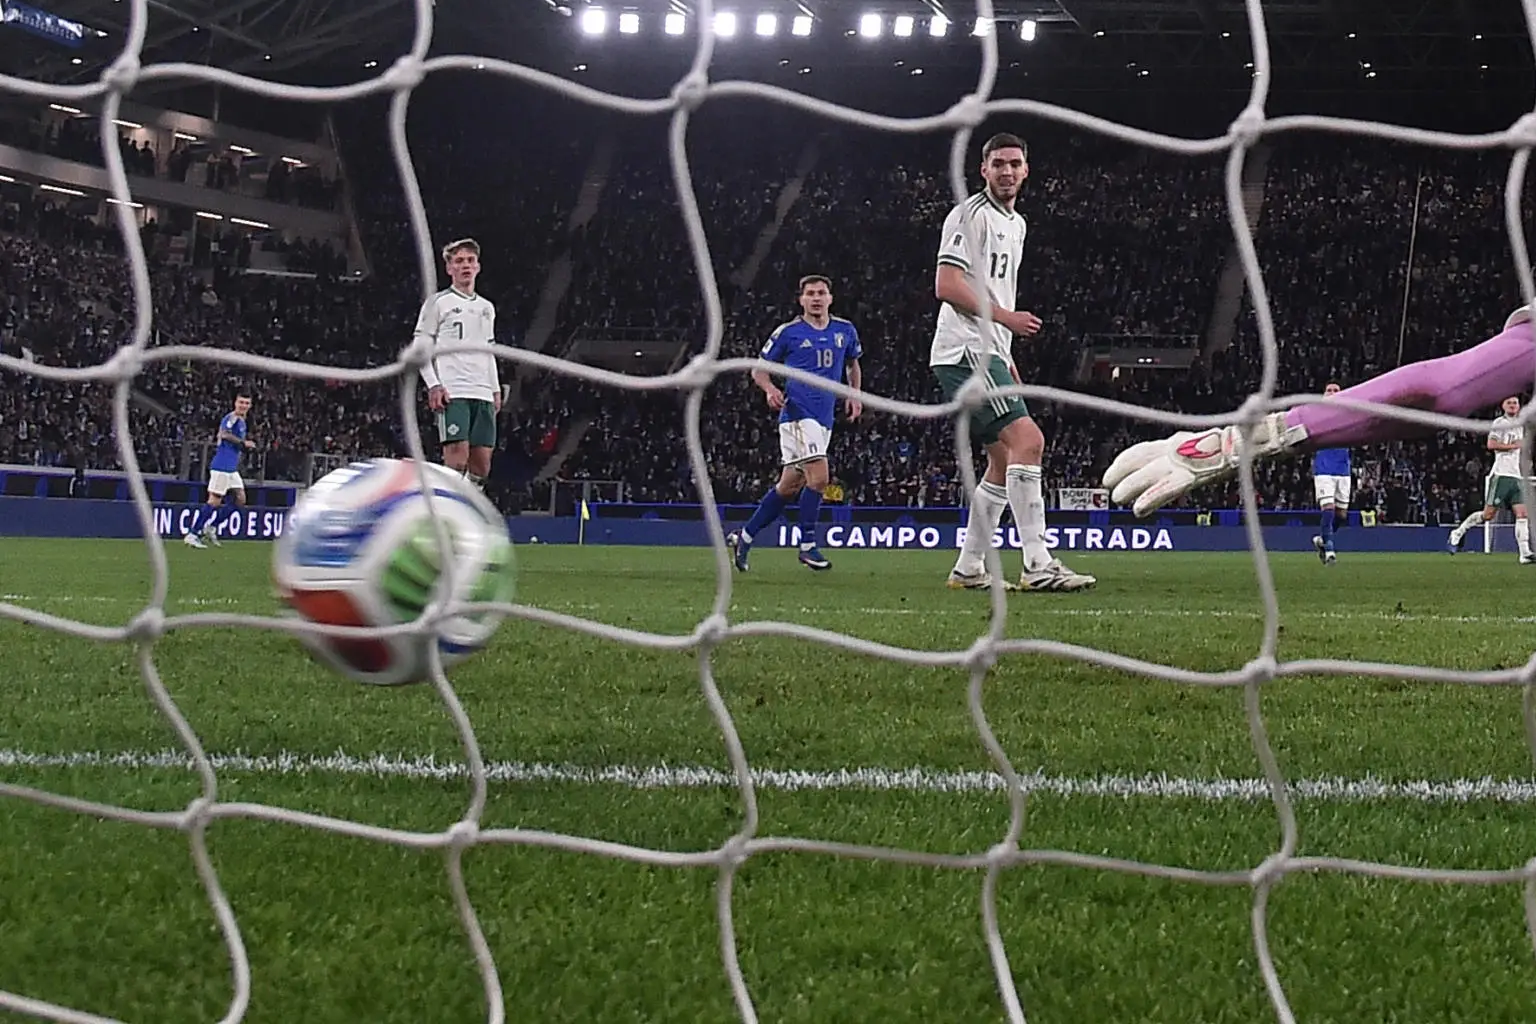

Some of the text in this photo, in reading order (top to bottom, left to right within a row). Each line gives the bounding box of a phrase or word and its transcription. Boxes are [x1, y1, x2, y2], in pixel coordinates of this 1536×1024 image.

[990, 252, 1009, 279] 13
[452, 321, 463, 341] 7
[816, 348, 834, 368] 18
[154, 507, 172, 534] IN
[247, 511, 258, 536] E
[263, 512, 283, 536] SU
[826, 526, 940, 547] CAMPO
[1044, 528, 1174, 549] STRADA
